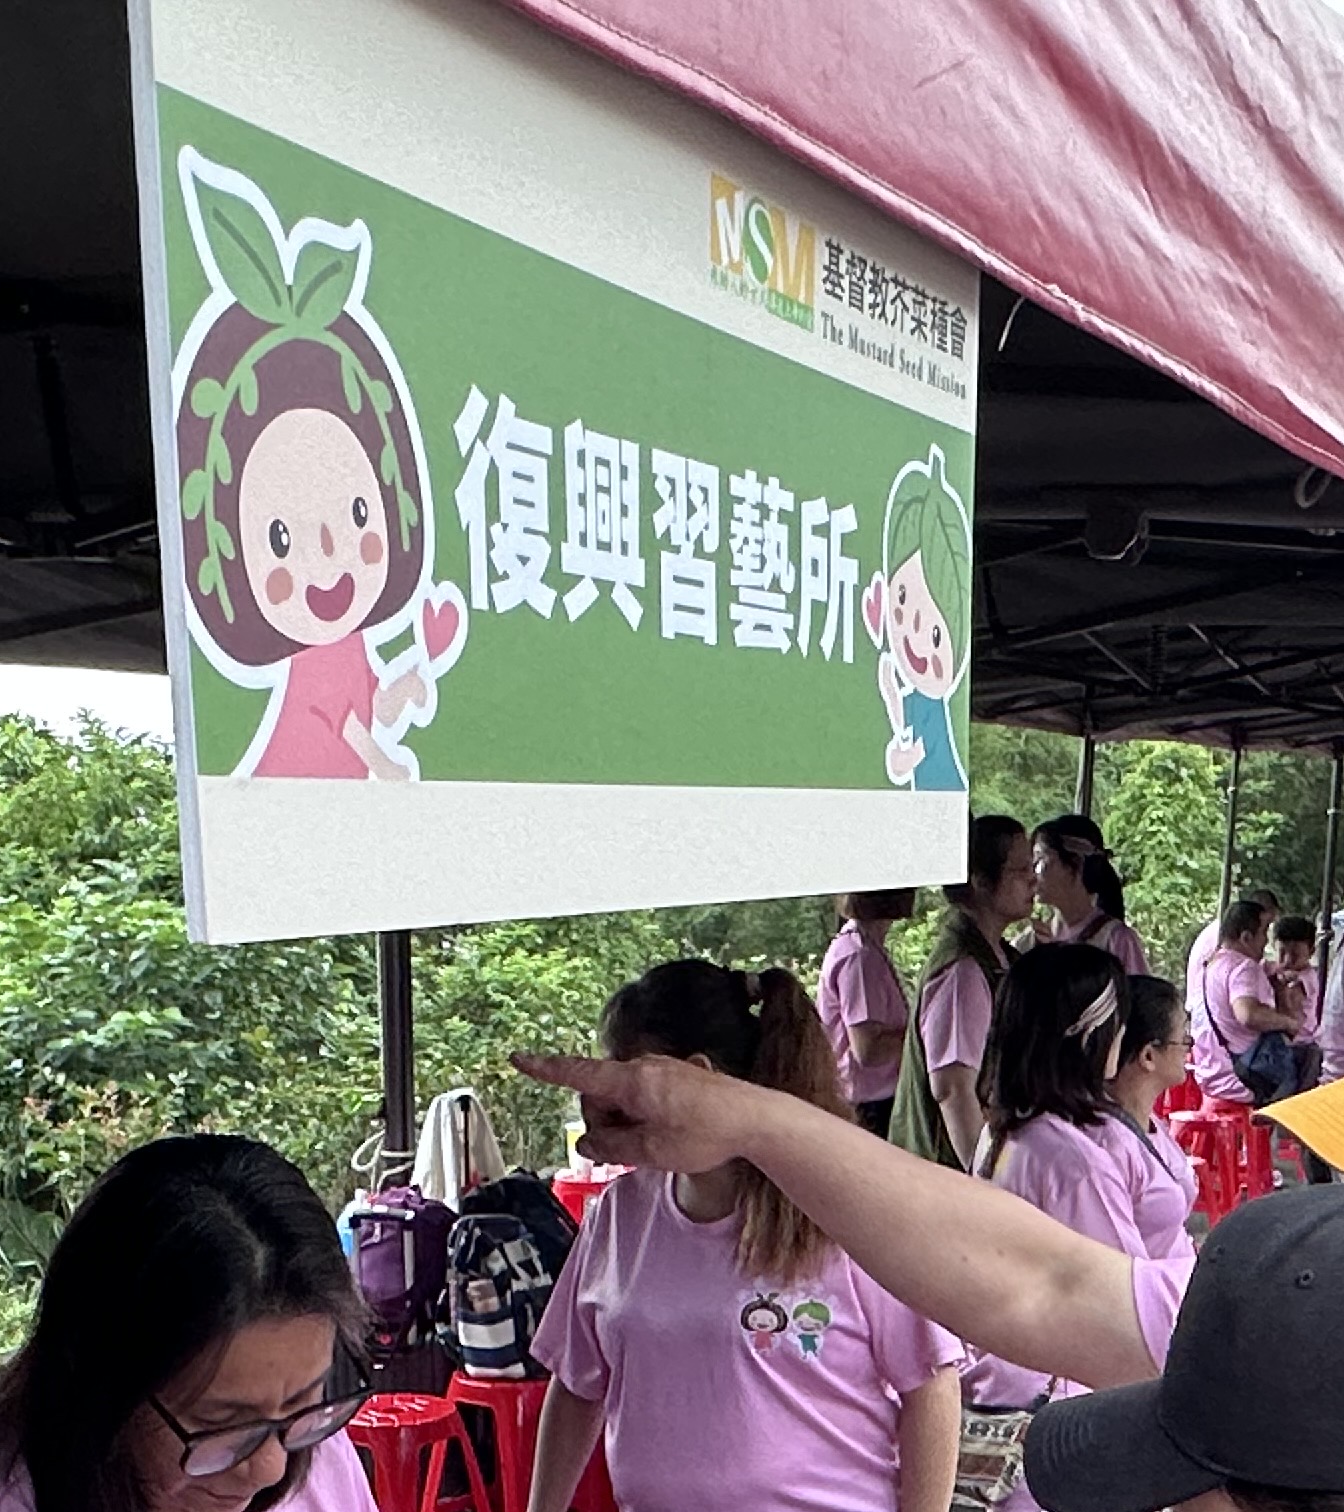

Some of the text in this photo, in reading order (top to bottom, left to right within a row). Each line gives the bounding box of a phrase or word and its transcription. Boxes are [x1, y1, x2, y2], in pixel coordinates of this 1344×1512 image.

[821, 311, 966, 399] The Mustard Seed Mission
[822, 238, 967, 361] 基督教芥菜種會
[453, 384, 859, 663] 復興習藝所
